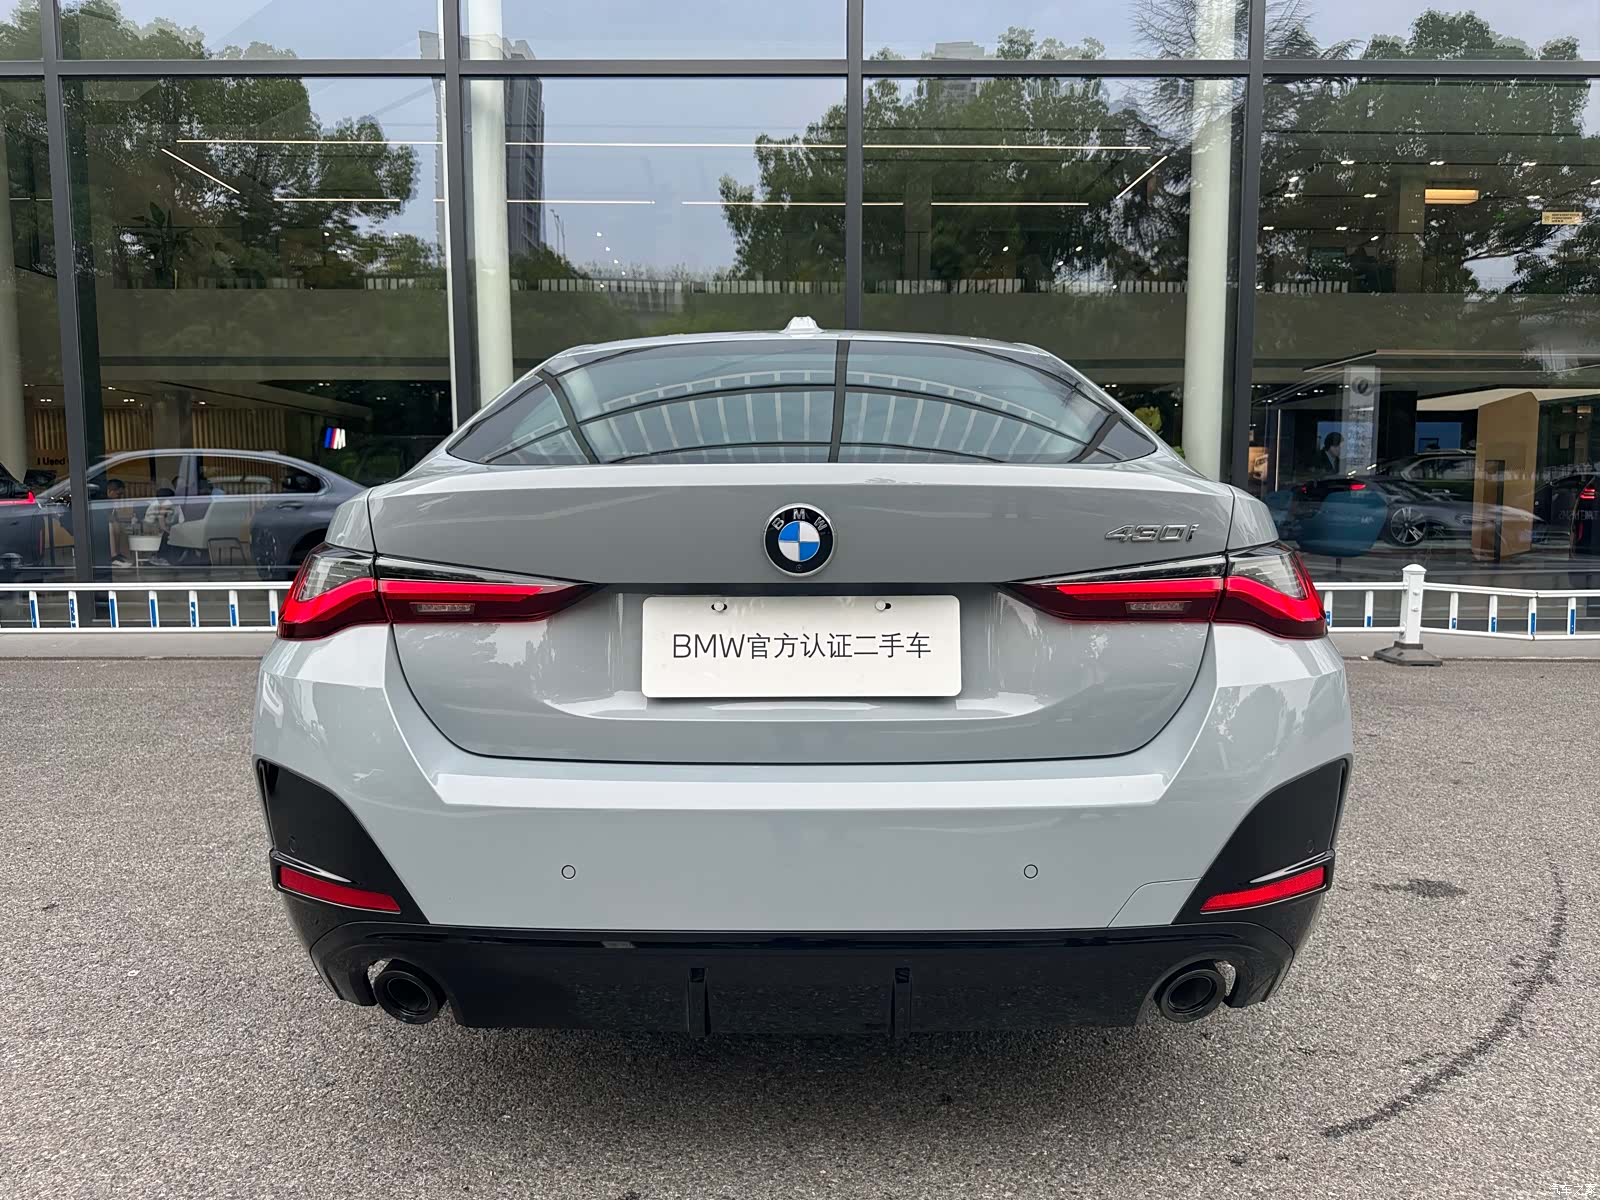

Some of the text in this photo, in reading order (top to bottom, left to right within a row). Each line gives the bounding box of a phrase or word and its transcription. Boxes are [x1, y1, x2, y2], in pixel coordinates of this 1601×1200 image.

[771, 508, 828, 531] BMW
[1105, 523, 1200, 542] 430i
[672, 631, 932, 660] BMW官方认证二手车
